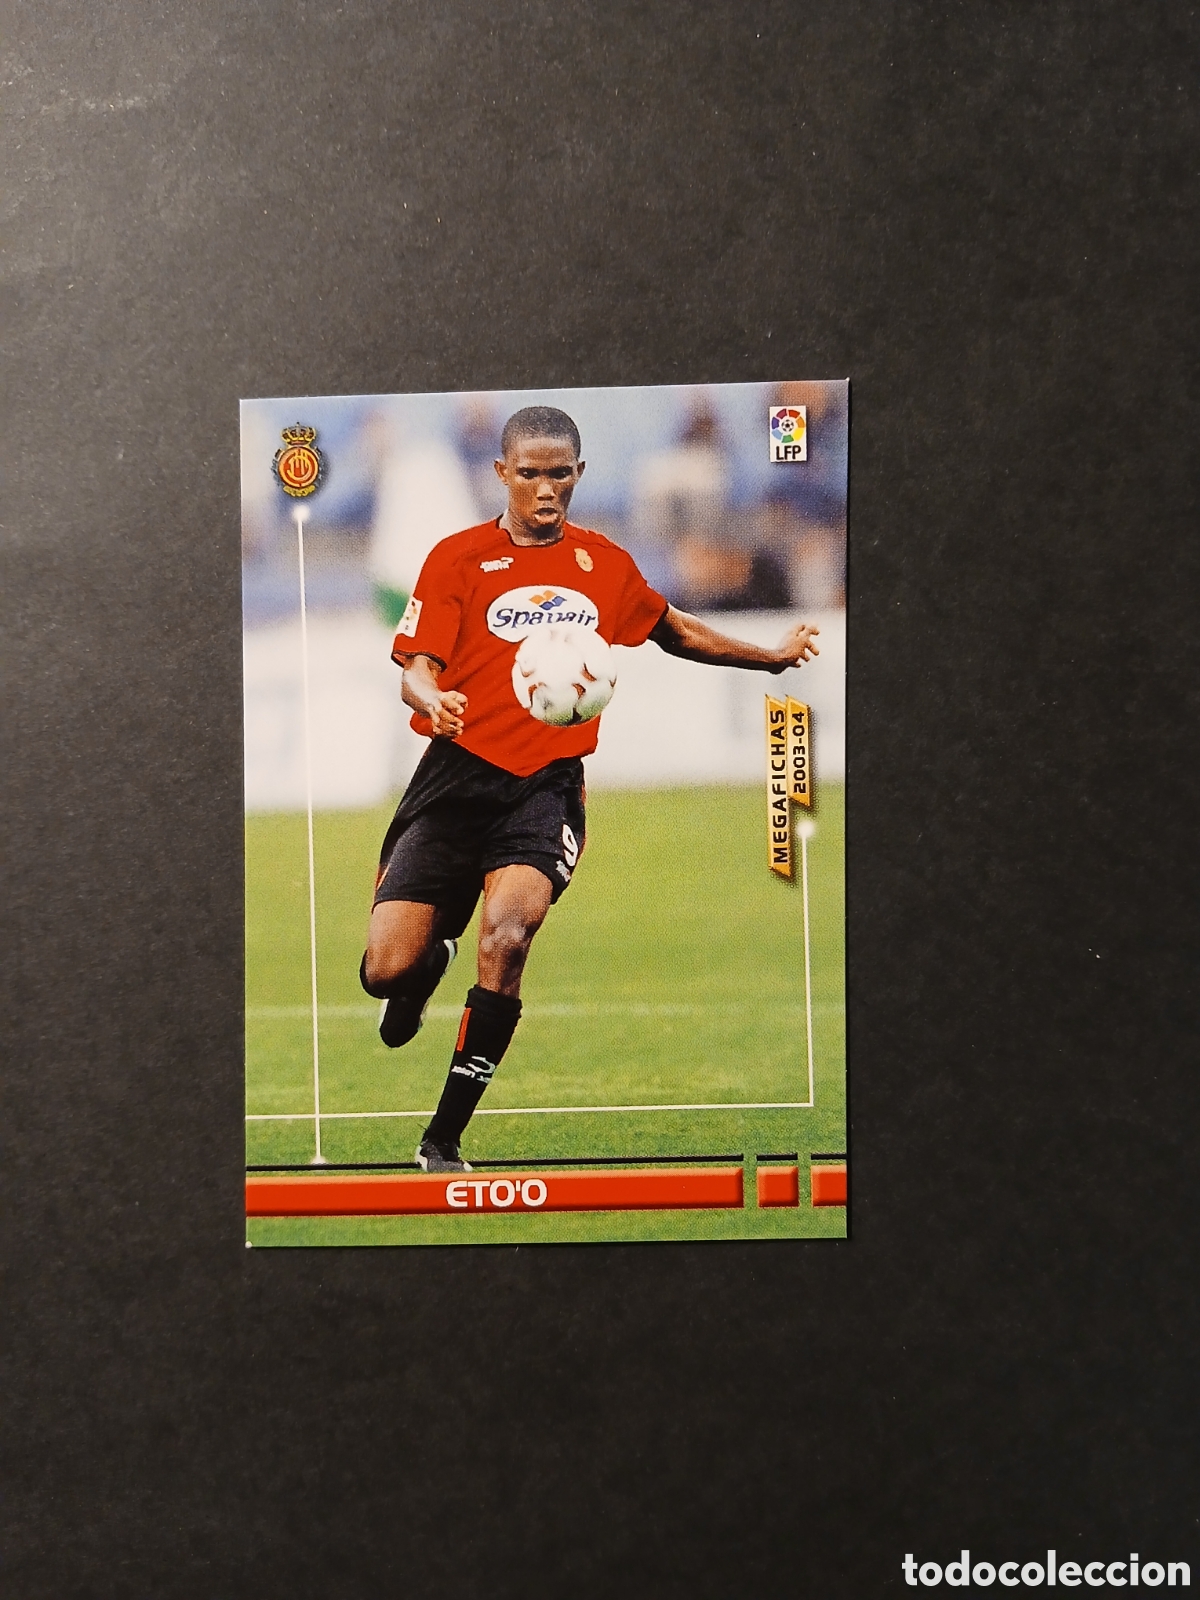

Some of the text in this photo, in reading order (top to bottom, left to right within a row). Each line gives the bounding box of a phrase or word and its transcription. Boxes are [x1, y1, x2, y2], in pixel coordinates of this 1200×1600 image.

[775, 445, 802, 461] LFP
[791, 711, 807, 794] 2003-04
[769, 709, 789, 864] MEGAFICHAS
[562, 823, 579, 867] 9
[445, 1178, 548, 1208] ETO'O
